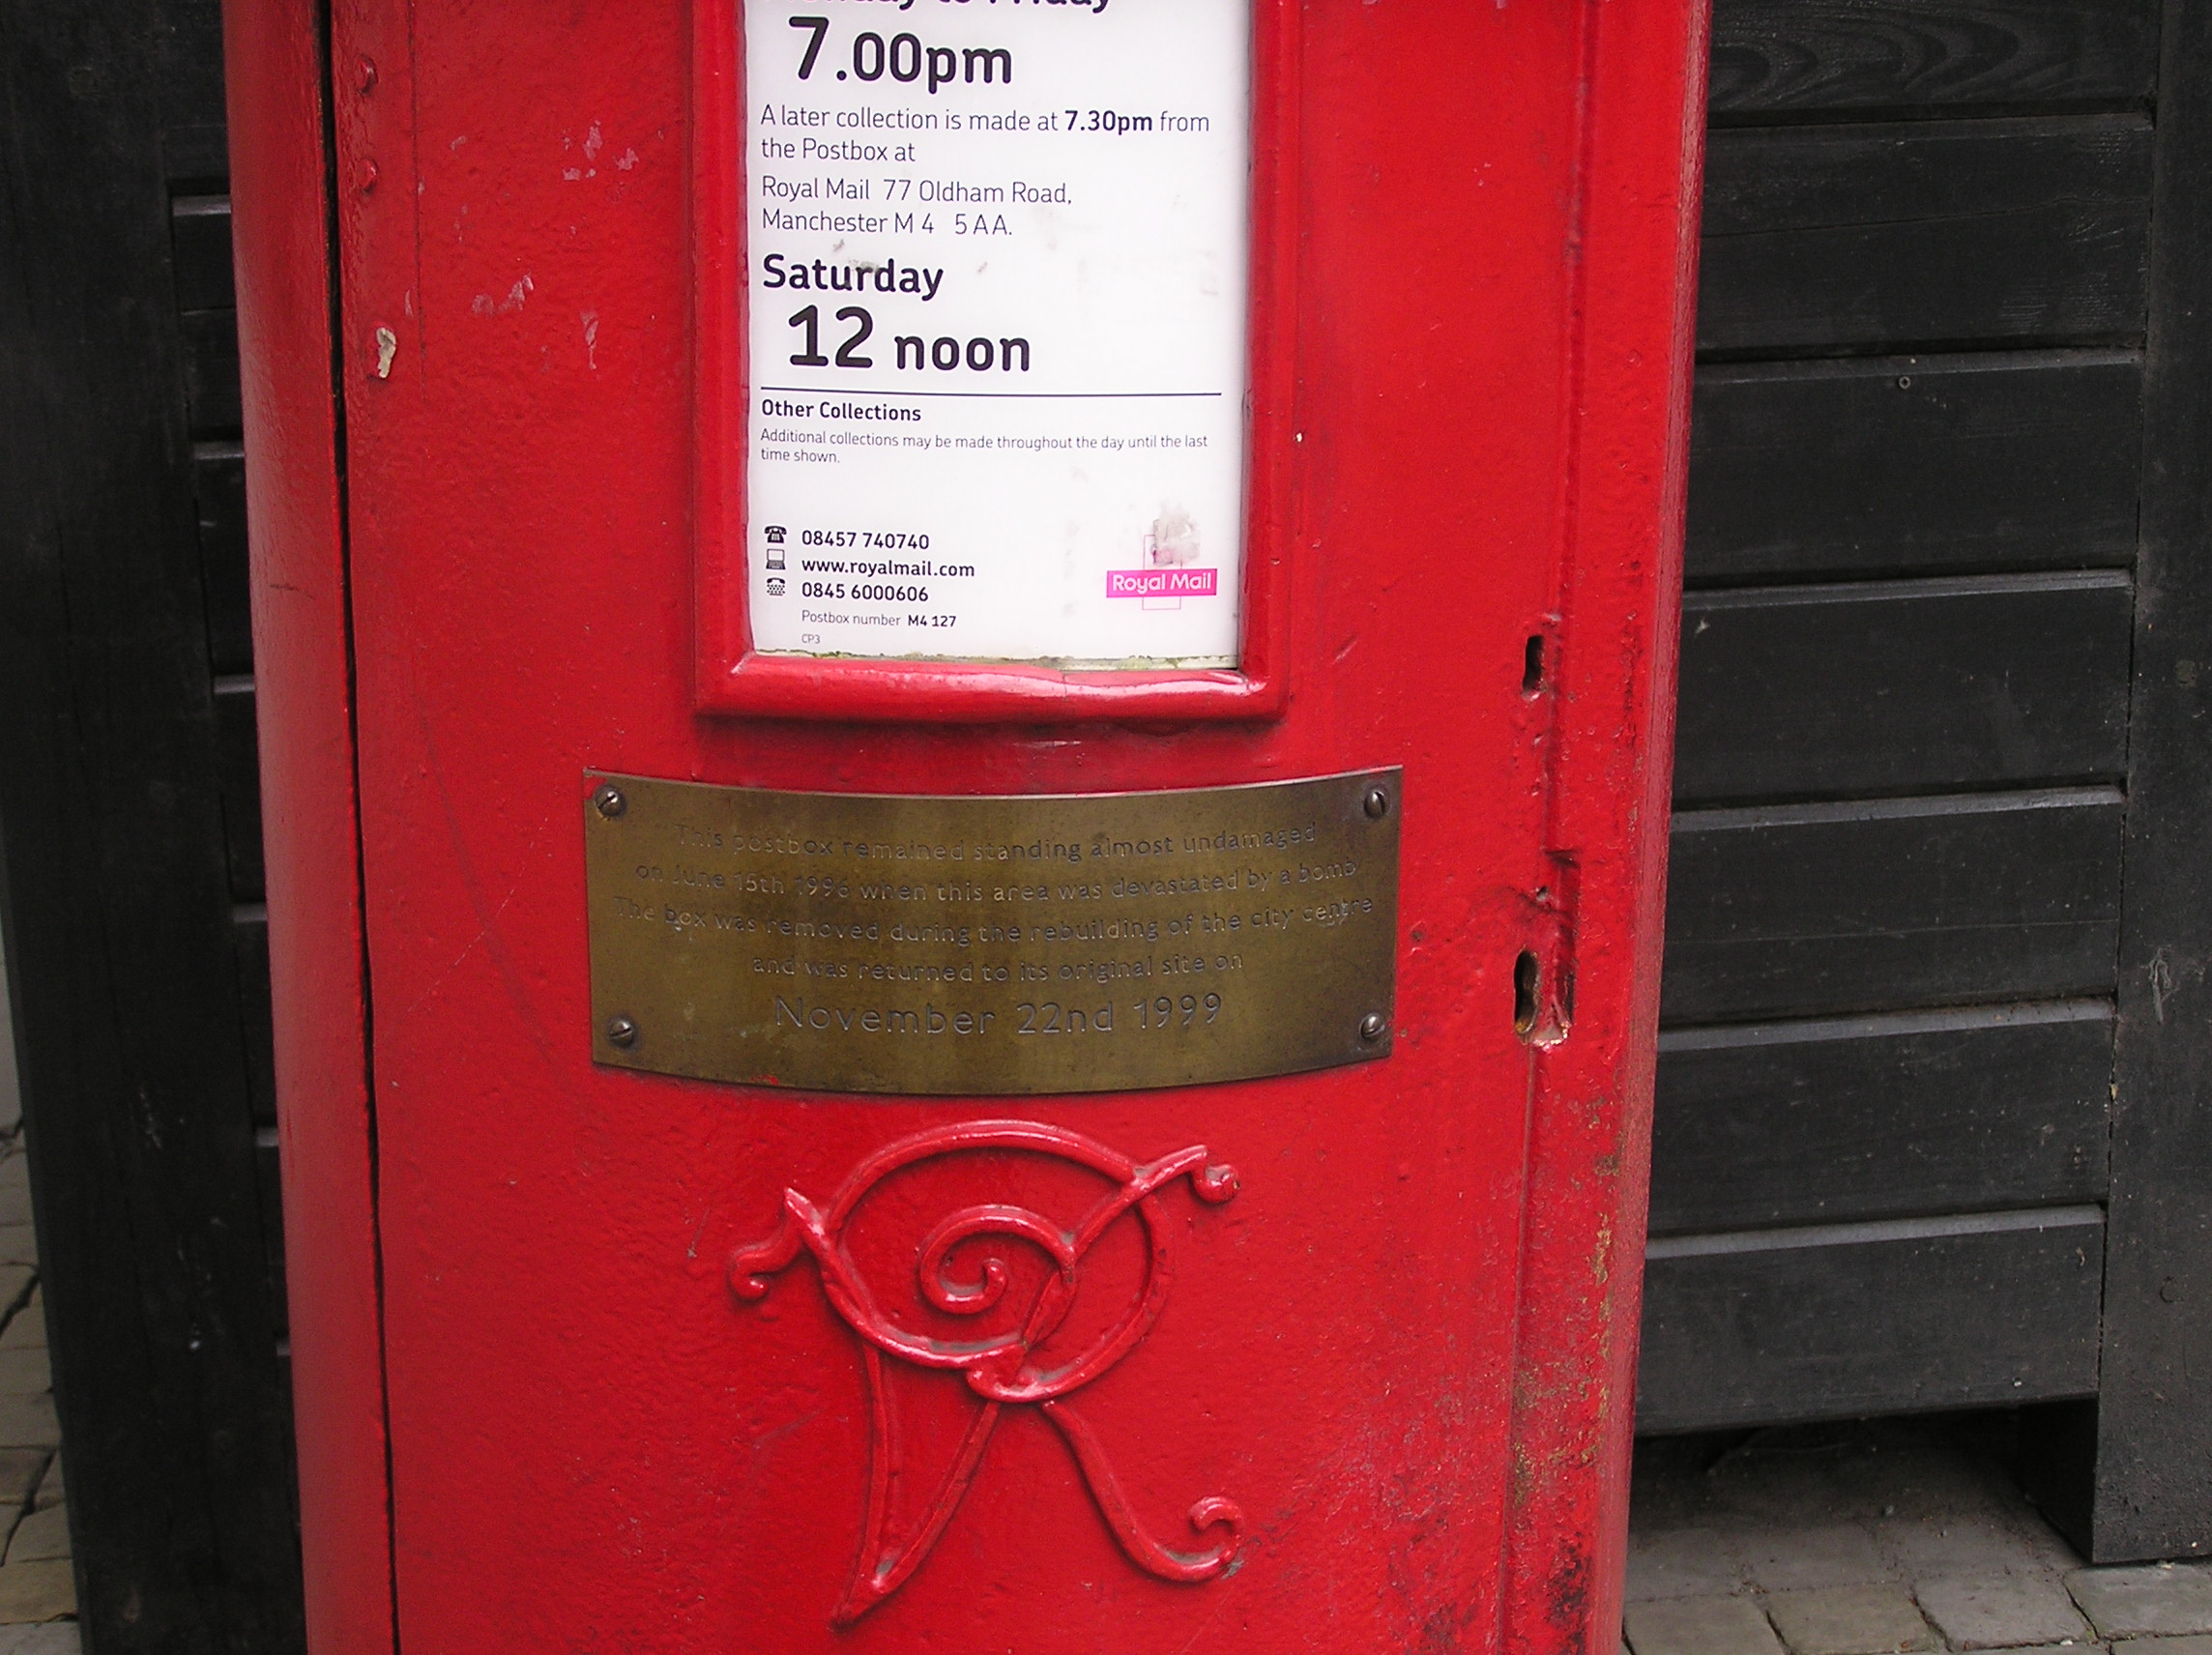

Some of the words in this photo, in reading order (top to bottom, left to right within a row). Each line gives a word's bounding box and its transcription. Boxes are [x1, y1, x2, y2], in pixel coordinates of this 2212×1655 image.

[788, 15, 1012, 95] 7.00pm
[760, 103, 776, 126] A
[781, 103, 830, 127] later
[836, 106, 938, 130] collection
[946, 108, 962, 131] is
[969, 109, 1031, 131] made
[1036, 111, 1059, 131] at
[1064, 109, 1153, 136] 7.30pm
[1160, 110, 1209, 132] from
[761, 136, 796, 159] the
[802, 137, 888, 161] Postbox
[894, 142, 916, 162] at
[762, 175, 819, 203] Royal
[826, 177, 870, 200] Mail
[883, 178, 912, 201] 77
[918, 179, 1004, 203] Oldham
[1012, 181, 1072, 205] Road,
[762, 207, 888, 233] Manchester
[763, 252, 945, 302] Saturday
[788, 304, 874, 369] 12
[893, 335, 1031, 372] noon
[761, 398, 815, 418] Other
[819, 400, 921, 421] Collections
[760, 427, 827, 444] Additional
[829, 431, 899, 447] collections
[902, 436, 932, 450] may
[935, 434, 952, 449] be
[955, 435, 994, 449] made
[997, 435, 1073, 452] throughout
[1076, 435, 1098, 449] the
[1100, 435, 1125, 451] day
[1128, 435, 1157, 449] until
[1160, 435, 1181, 448] the
[1184, 434, 1208, 448] last
[761, 448, 791, 461] time
[793, 449, 842, 464] shown.
[801, 529, 858, 548] 08457
[861, 532, 930, 550] 740740
[800, 559, 975, 578] www.royalmail.com
[801, 581, 846, 599] 0845
[851, 584, 929, 602] 6000606
[1112, 572, 1166, 595] Royal
[1170, 571, 1212, 591] Mail
[801, 609, 850, 624] Postbox
[853, 613, 902, 626] number
[907, 614, 928, 627] M4
[931, 615, 957, 627] 127
[800, 633, 821, 645] CP3
[675, 823, 723, 848] This
[733, 831, 833, 856] postbox
[842, 839, 965, 860] remained
[974, 839, 1081, 864] standing
[1090, 836, 1175, 858] almost
[1182, 822, 1316, 853] undamaged
[635, 864, 663, 883] on
[672, 865, 725, 888] June
[735, 872, 784, 895] 15th
[795, 875, 851, 898] 1996
[859, 879, 927, 901] when
[937, 880, 983, 901] this
[993, 885, 1050, 902] area
[1058, 884, 1102, 900] was
[1112, 869, 1238, 899] devastated
[1247, 868, 1272, 891] by
[1279, 869, 1291, 885] a
[1299, 857, 1356, 884] bomb
[613, 896, 655, 921] The
[664, 903, 707, 927] box
[714, 916, 758, 933] was
[764, 919, 880, 941] removed
[889, 921, 971, 947] during
[978, 923, 1022, 943] the
[1030, 916, 1158, 943] rebuilding
[1167, 914, 1193, 936] of
[1202, 912, 1241, 932] the
[1250, 905, 1294, 930] city
[1302, 894, 1373, 921] centre
[752, 956, 796, 974] and
[803, 961, 849, 978] was
[858, 961, 974, 982] returned
[981, 963, 1009, 982] to
[1020, 961, 1049, 981] its
[1058, 954, 1153, 984] original
[1161, 951, 1207, 975] site
[1213, 954, 1243, 972] on
[774, 994, 996, 1034] November
[1016, 1000, 1114, 1035] 22nd
[1133, 991, 1222, 1030] 1999
